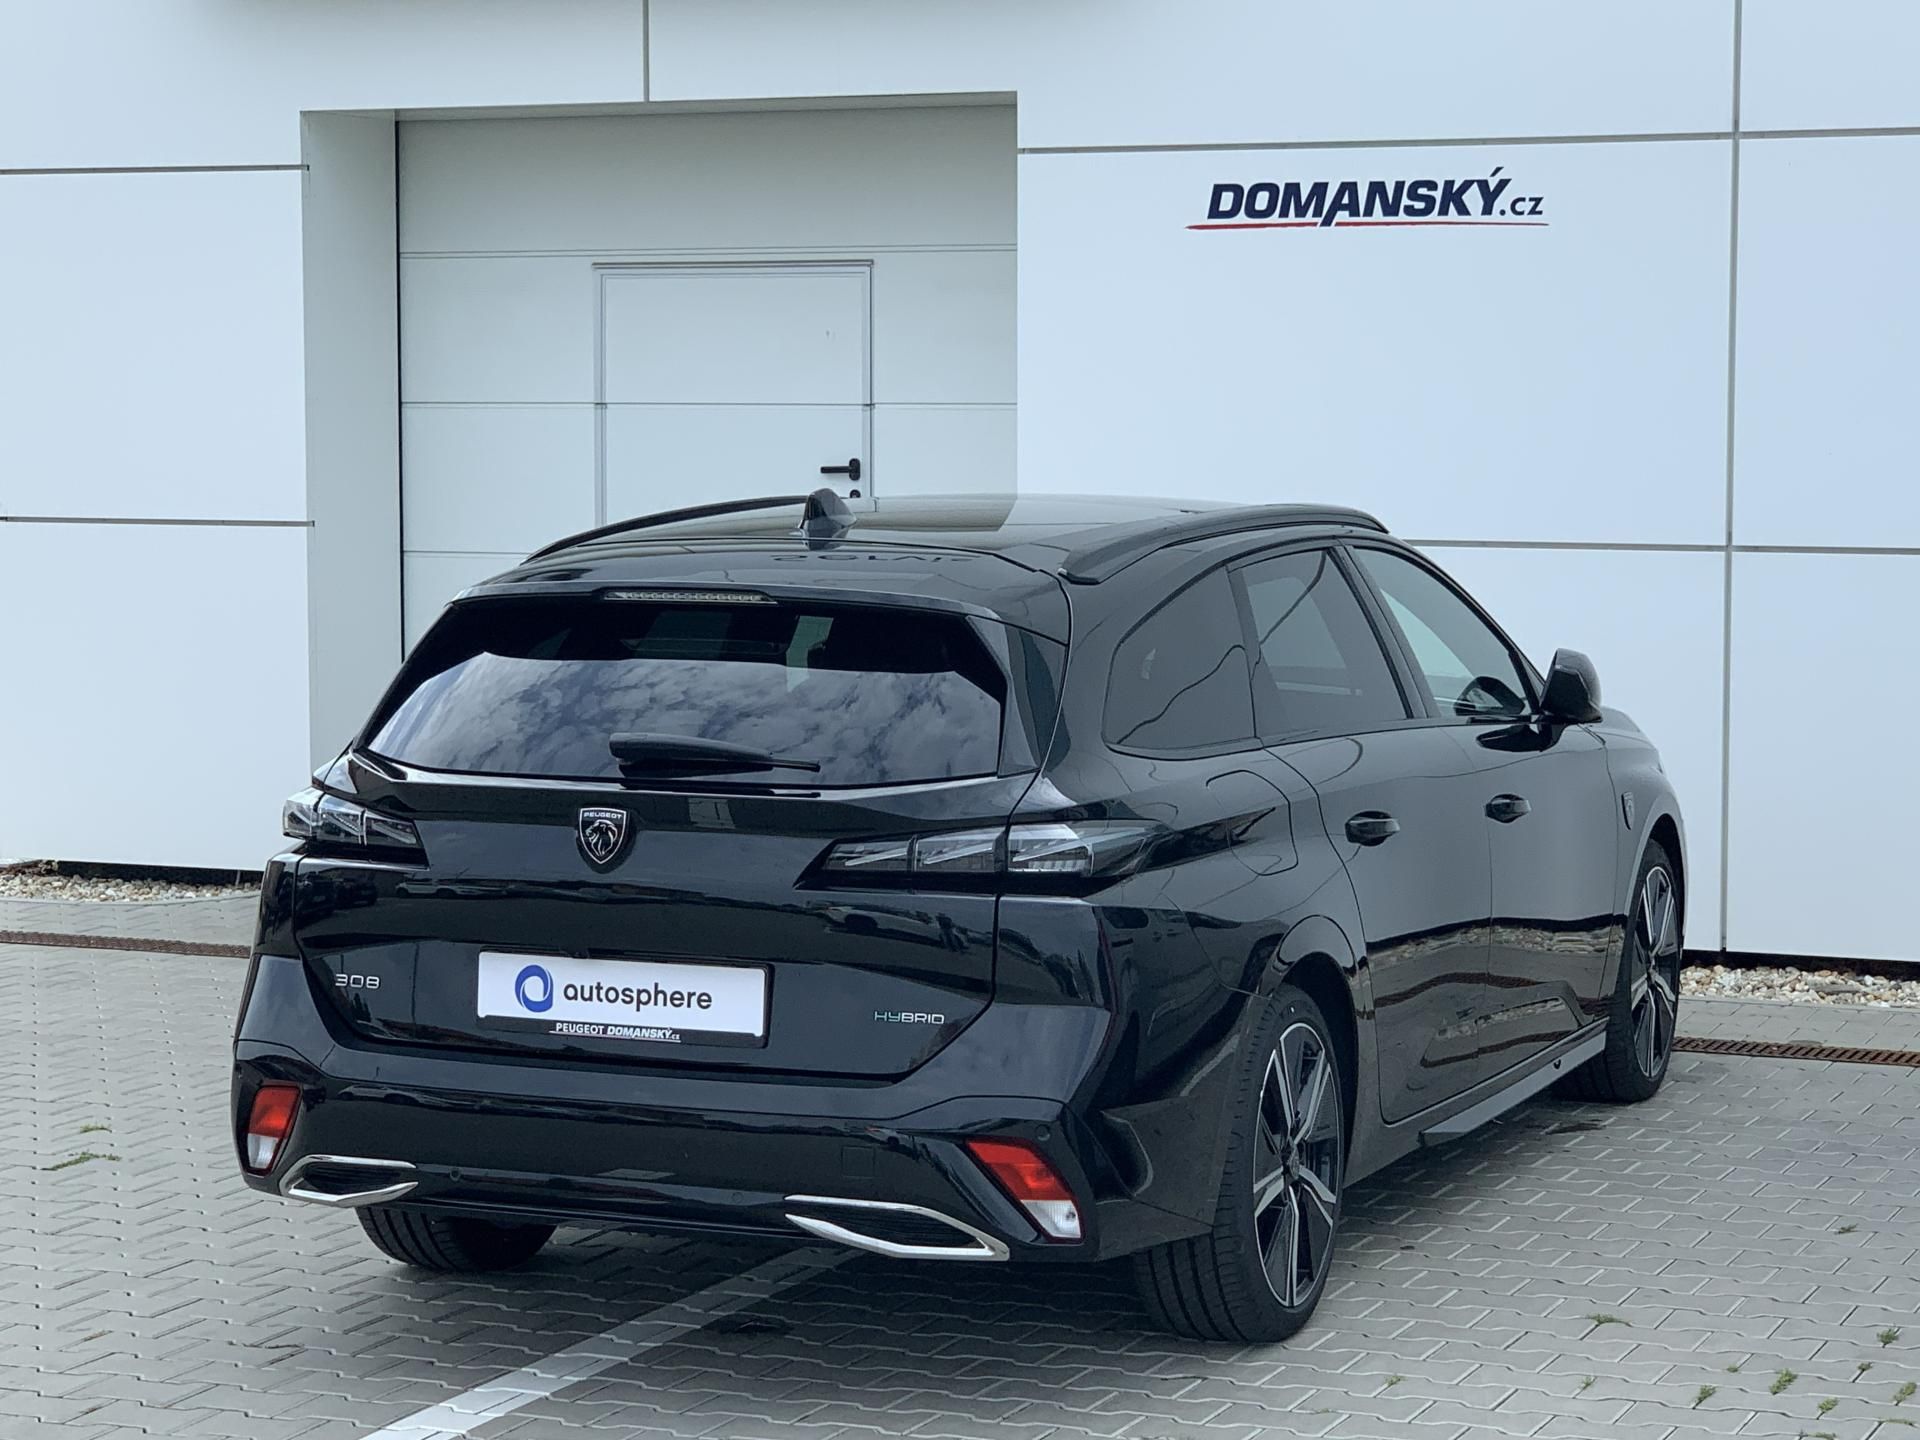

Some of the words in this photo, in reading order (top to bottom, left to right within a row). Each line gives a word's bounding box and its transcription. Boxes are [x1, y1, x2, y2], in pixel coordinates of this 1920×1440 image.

[334, 973, 380, 989] 308
[563, 982, 713, 1012] autosphere
[874, 1011, 945, 1024] HYBRID
[555, 1022, 604, 1035] PEUGEOT
